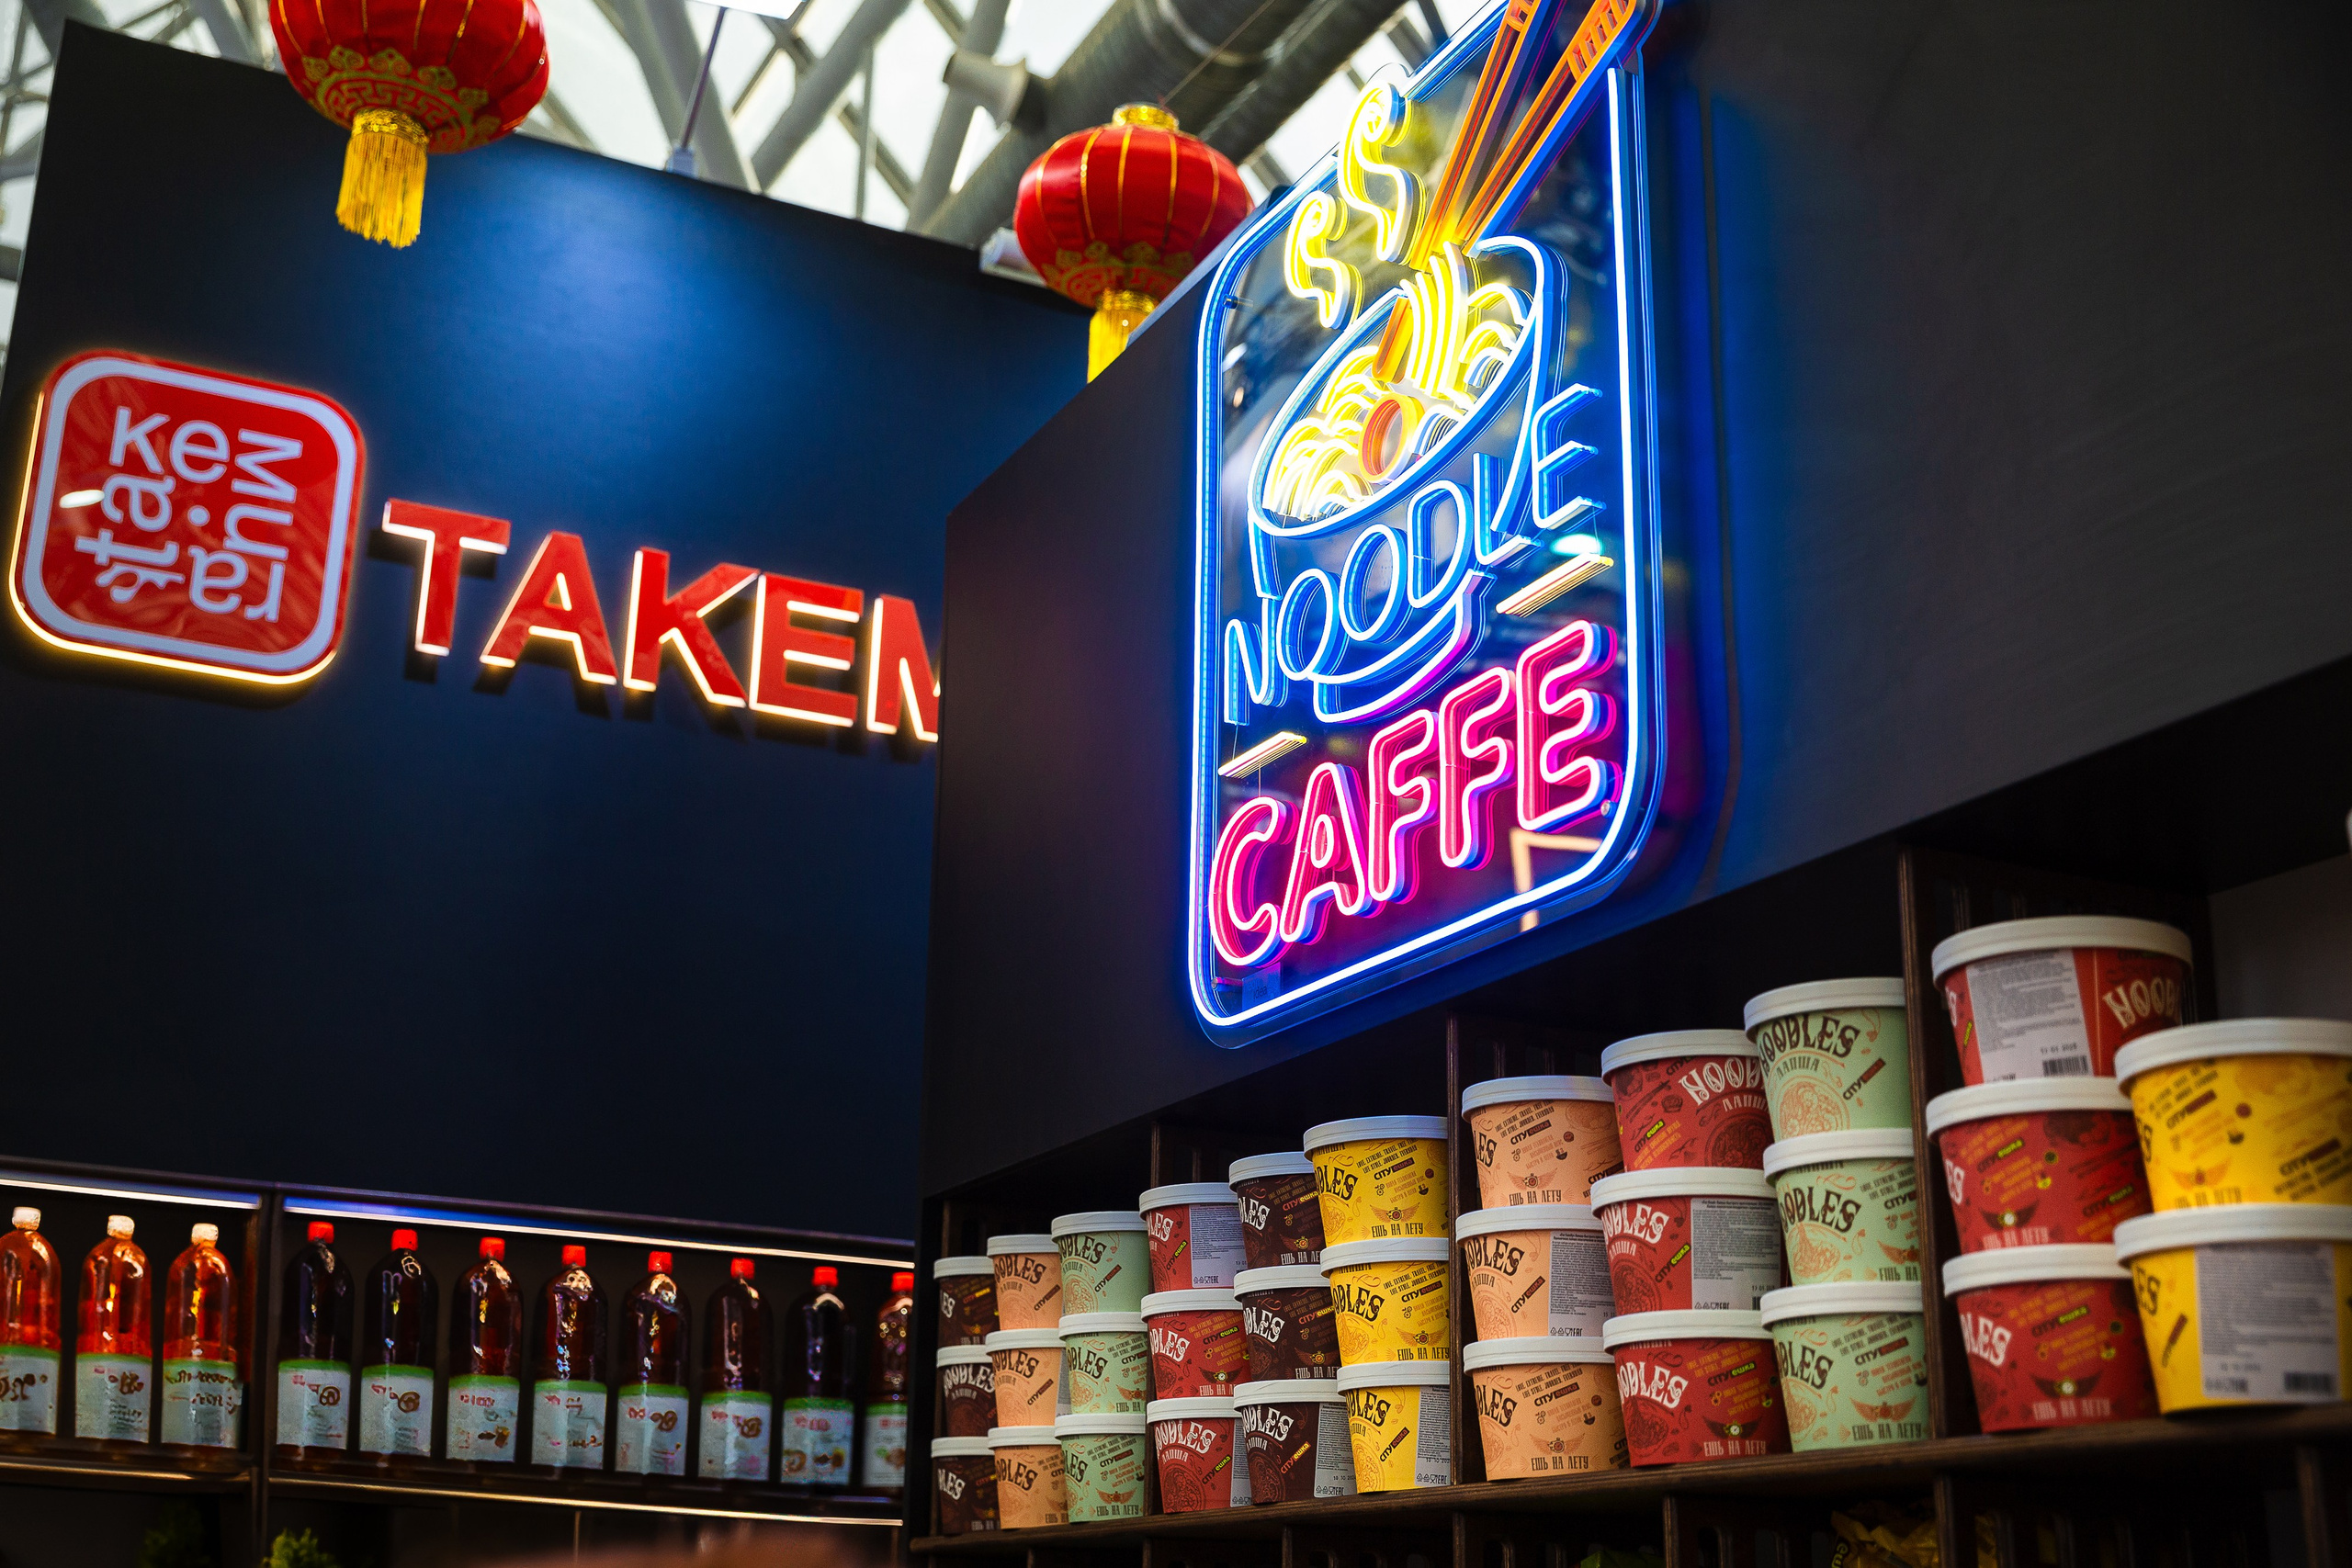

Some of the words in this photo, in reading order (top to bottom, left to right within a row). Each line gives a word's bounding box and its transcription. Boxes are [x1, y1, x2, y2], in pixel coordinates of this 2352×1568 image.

[1224, 383, 1605, 724] NOODLE
[1209, 619, 1622, 967] CAFFE
[1374, 1156, 1416, 1180] CITYешка
[1371, 1224, 1388, 1238] ЕШЬ
[1390, 1224, 1401, 1235] НА
[1405, 1223, 1424, 1235] ЛЕТУ
[1401, 1280, 1443, 1303] CITYешка
[1202, 1325, 1239, 1346] CITYешка
[1396, 1348, 1414, 1361] ЕШЬ
[1417, 1347, 1429, 1359] НА
[1431, 1347, 1450, 1359] ЛЕТУ
[1313, 1366, 1325, 1379] НА
[1216, 1383, 1227, 1396] НА
[1533, 1382, 1580, 1406] CITYешка
[1531, 1457, 1549, 1471] ЕШЬ
[1552, 1456, 1565, 1470] НА
[1567, 1455, 1589, 1470] ЛЕТУ
